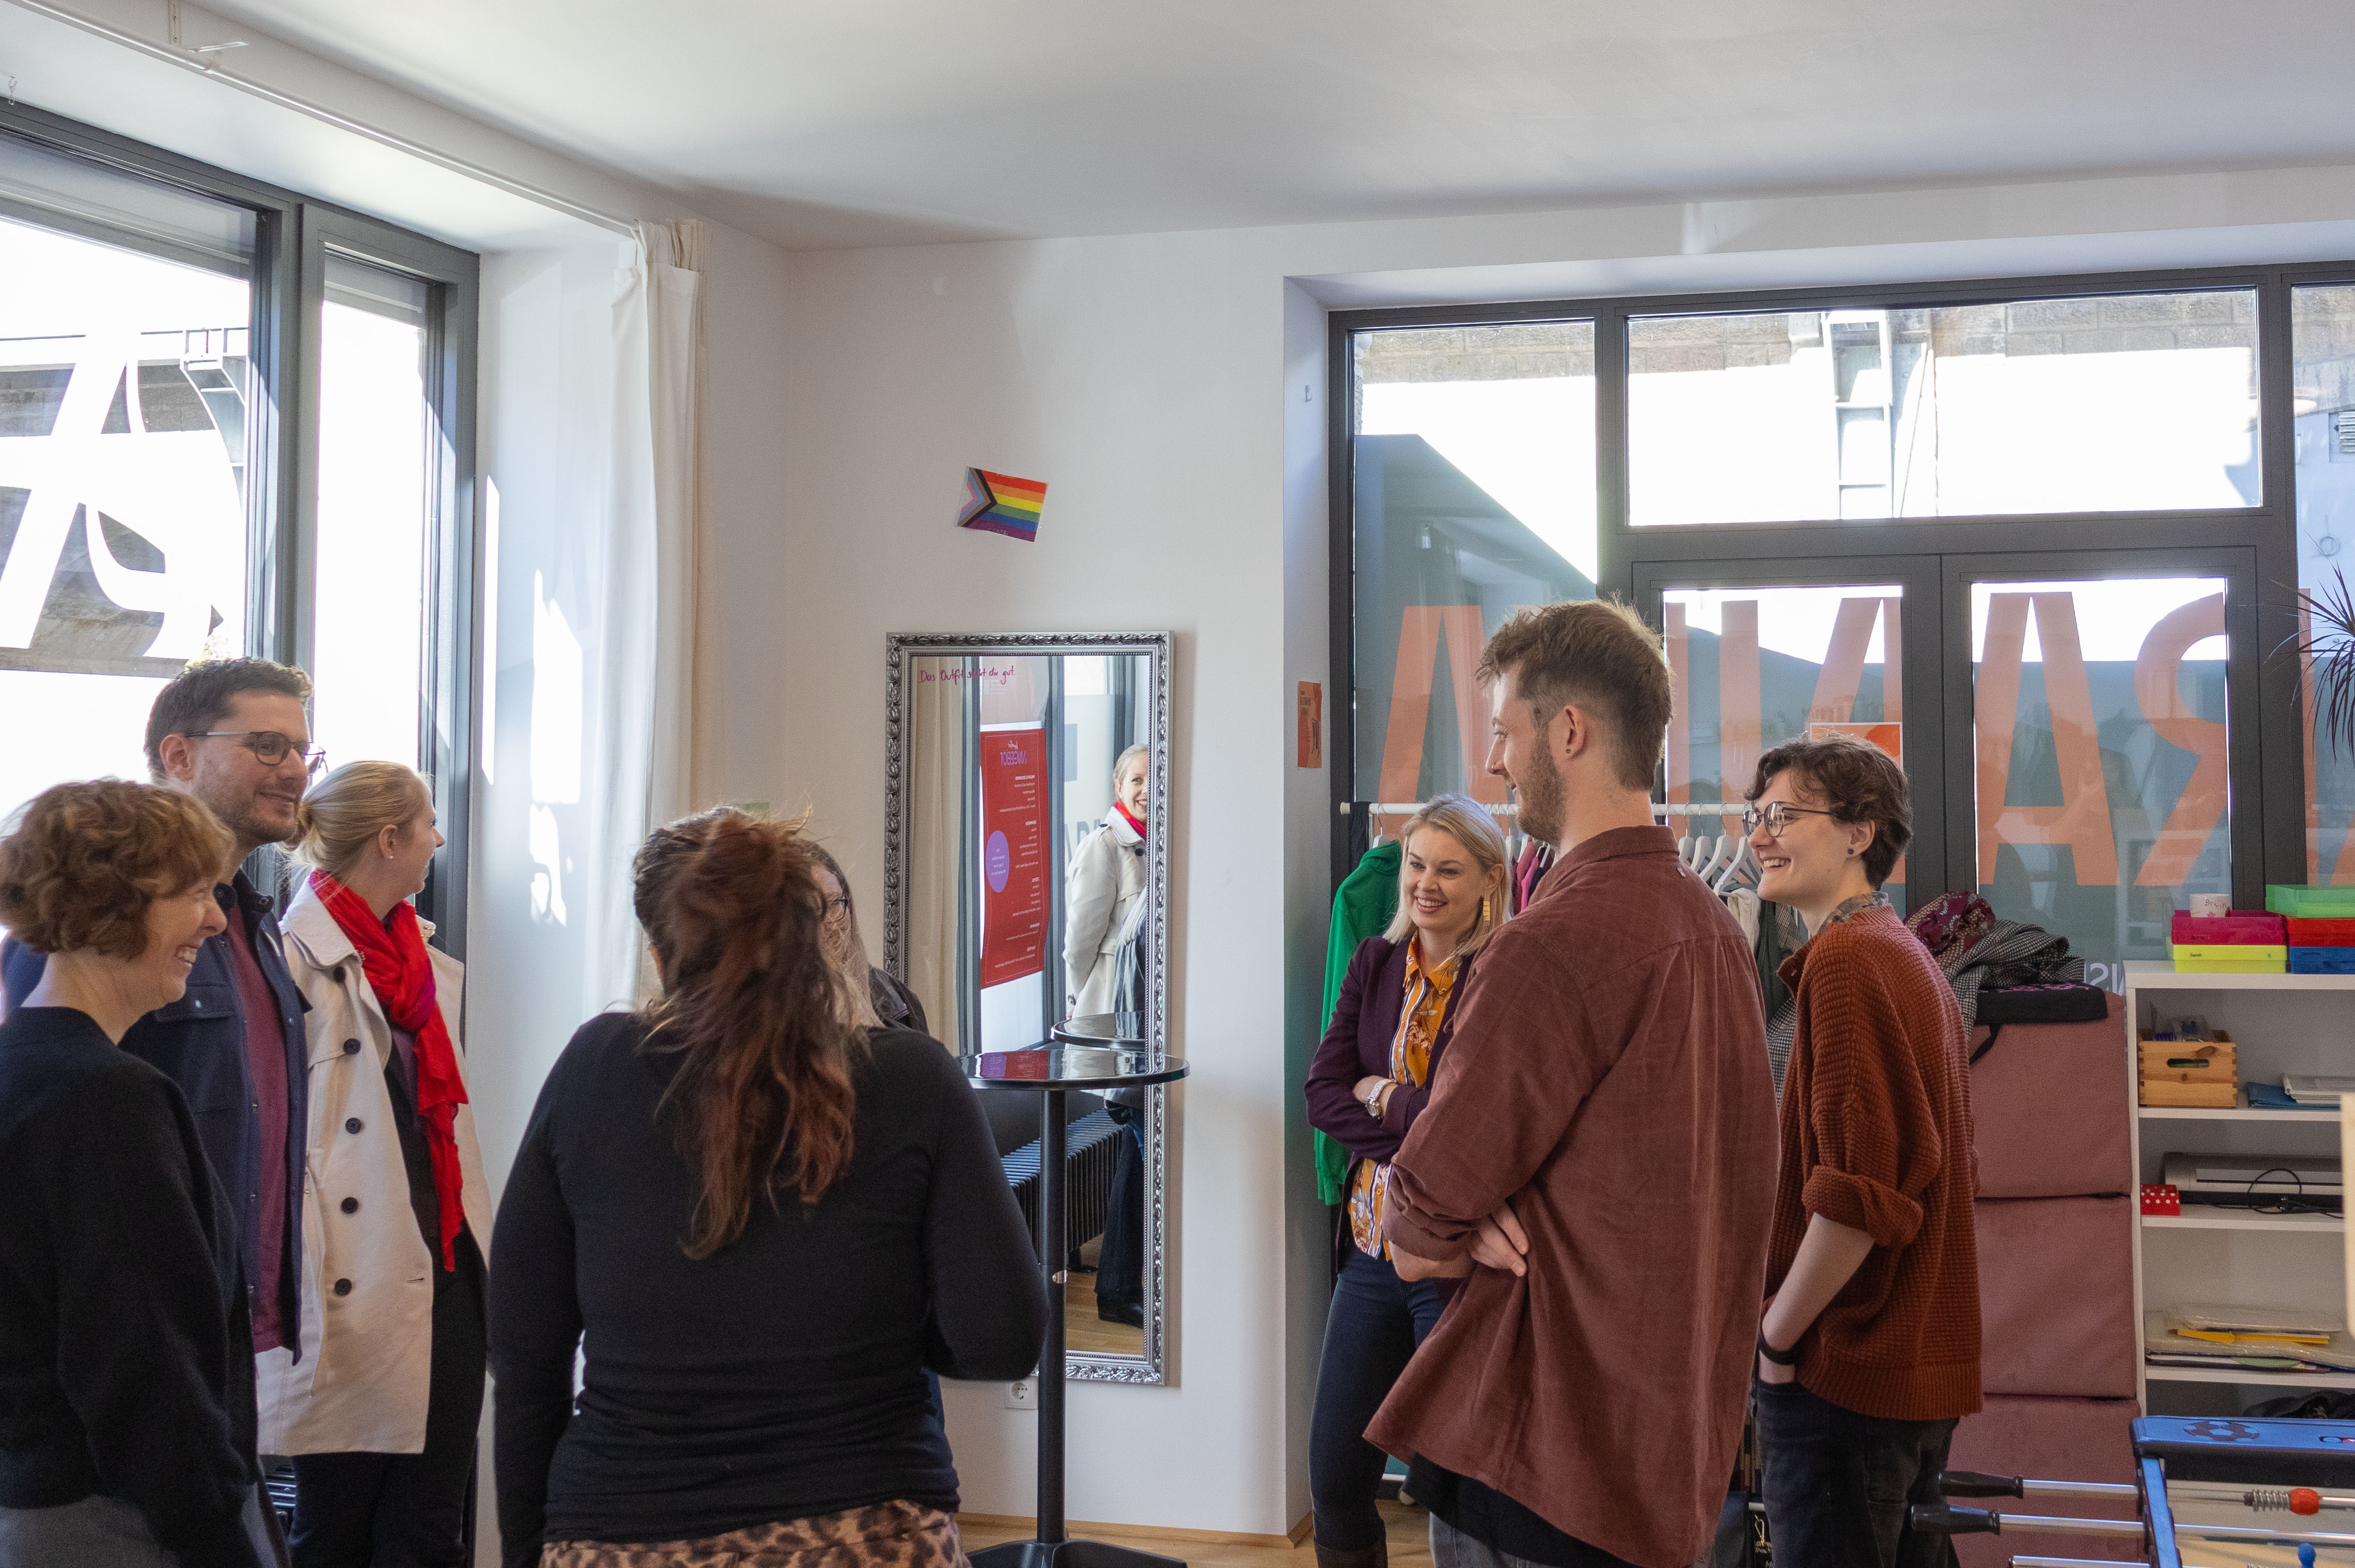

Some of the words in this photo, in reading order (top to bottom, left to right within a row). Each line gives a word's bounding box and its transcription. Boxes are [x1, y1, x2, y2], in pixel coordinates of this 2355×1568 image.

[919, 670, 936, 683] Das
[940, 669, 964, 685] Outfit
[989, 667, 999, 676] dir
